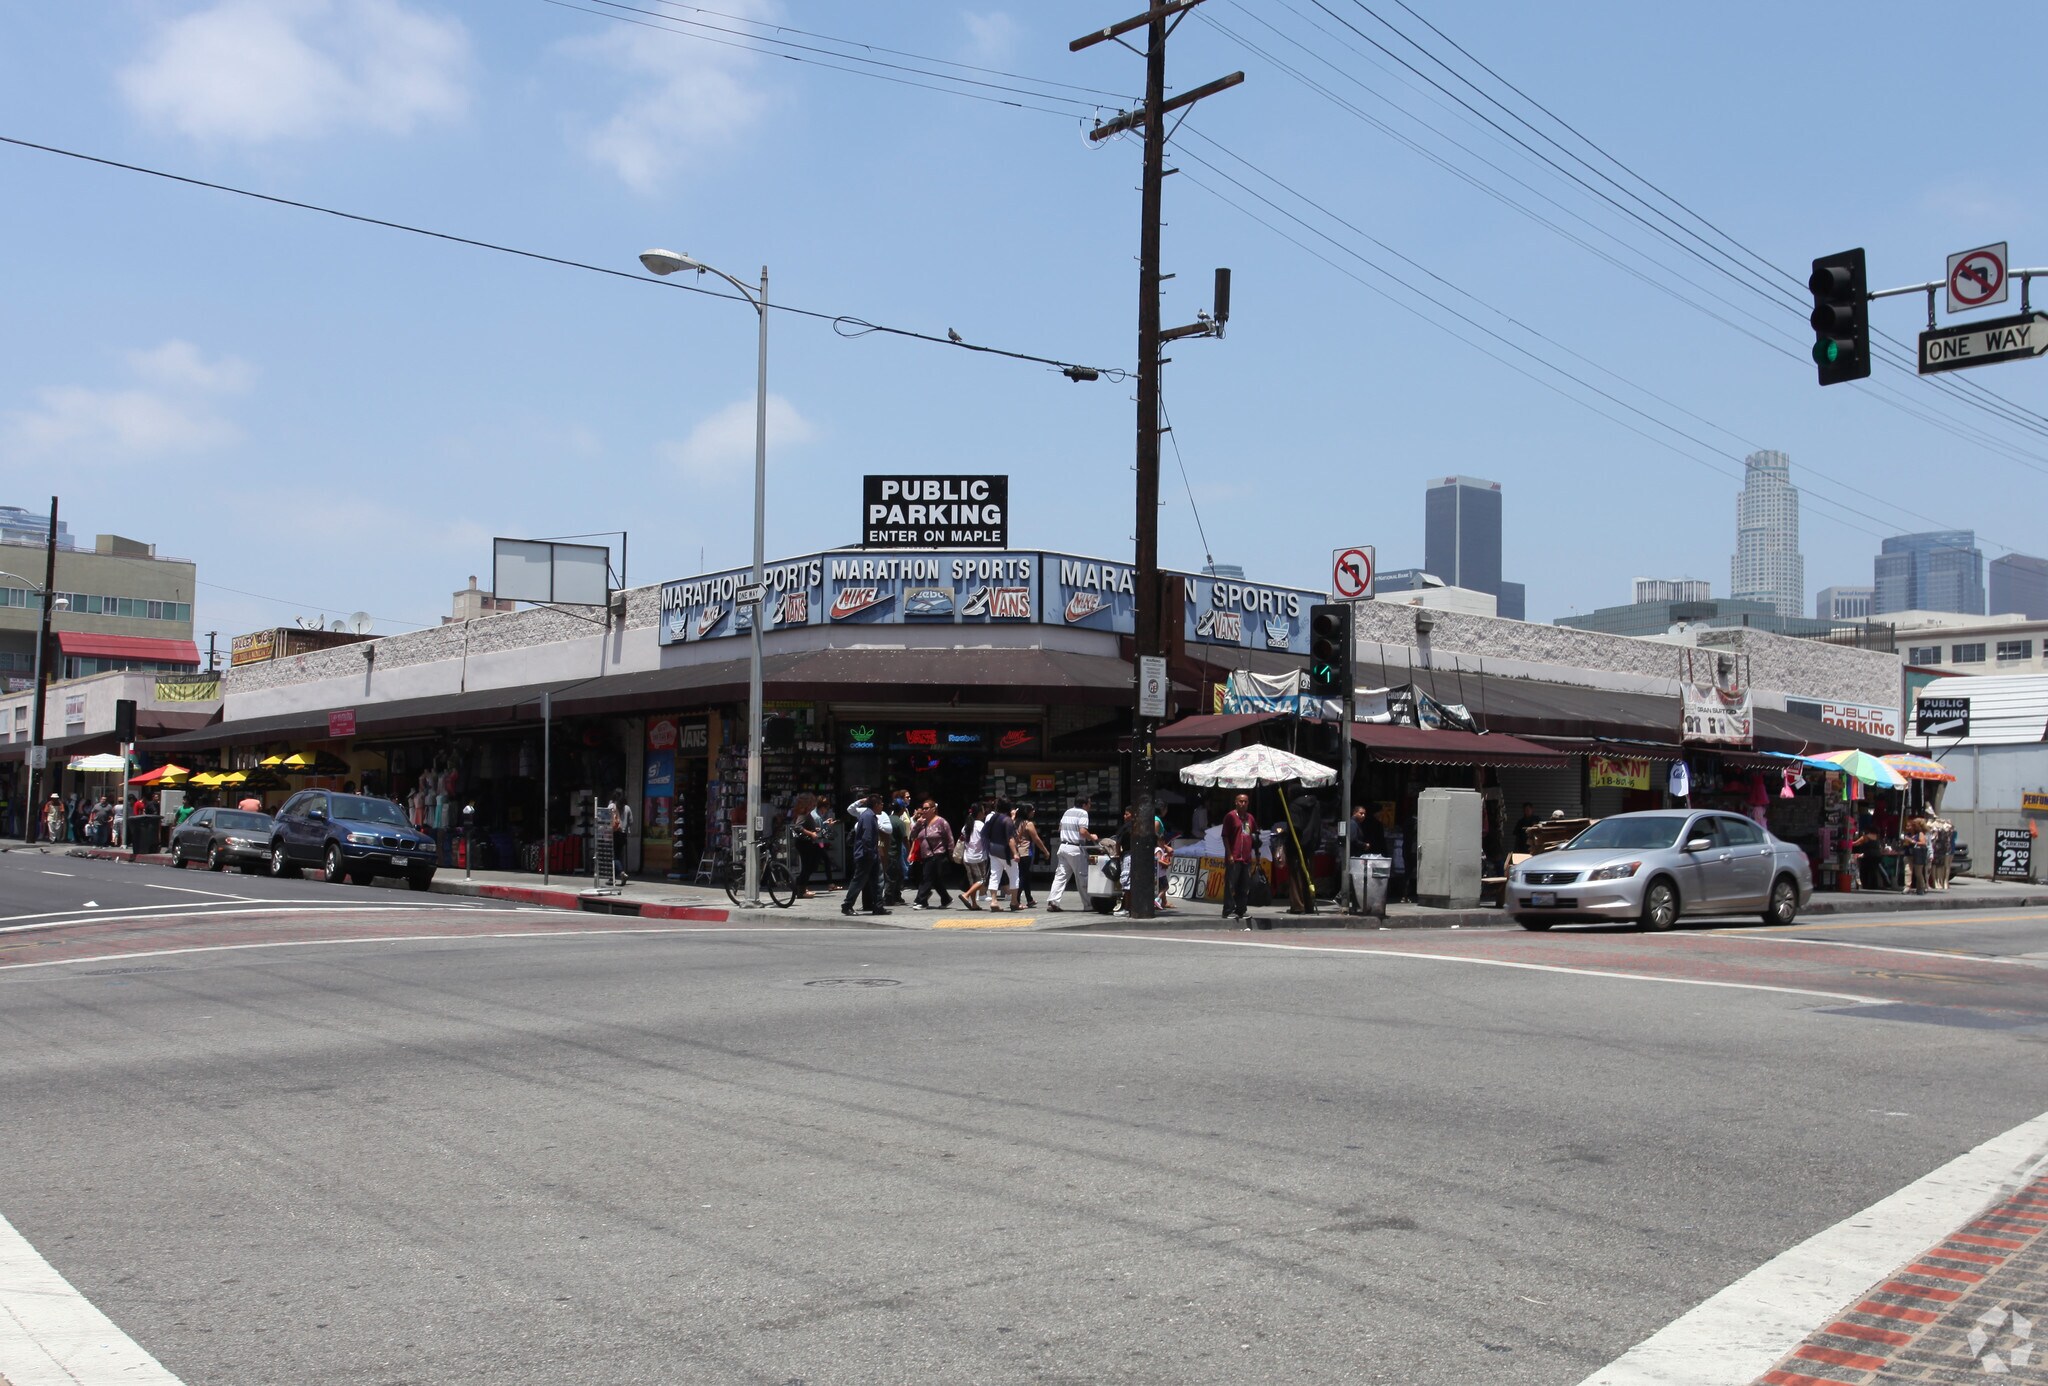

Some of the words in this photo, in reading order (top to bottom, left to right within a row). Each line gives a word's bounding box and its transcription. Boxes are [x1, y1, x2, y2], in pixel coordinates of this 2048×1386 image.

[1929, 336, 1970, 361] ONE
[1986, 325, 2031, 352] WAY
[882, 480, 990, 501] PUBLIC
[869, 504, 1001, 525] PARKING
[869, 530, 918, 542] ENTER
[923, 530, 945, 542] ON
[951, 530, 1001, 542] MAPLE
[831, 559, 939, 580] MARATHON
[952, 558, 1031, 580] SPORTS
[662, 574, 746, 609] MARATHON
[764, 559, 822, 592] PORTS
[738, 590, 748, 600] ONE
[748, 589, 758, 599] WAY
[838, 588, 876, 606] NIKE
[988, 587, 1031, 618] VANS
[1074, 592, 1100, 613] NIKE
[1213, 582, 1300, 618] SPORTS
[785, 592, 807, 623] VANS
[1214, 611, 1241, 641] VANS
[1267, 638, 1289, 648] adidas
[1823, 704, 1883, 721] PUBLIC
[1923, 699, 1963, 708] PUBLIC
[1919, 709, 1968, 718] PARKING
[680, 724, 707, 748] VANS
[948, 734, 981, 743] Reebok
[1007, 729, 1027, 738] NIKE
[850, 741, 874, 749] adidas
[1997, 830, 2030, 839] PUBLIC
[1172, 864, 1196, 873] CLUB
